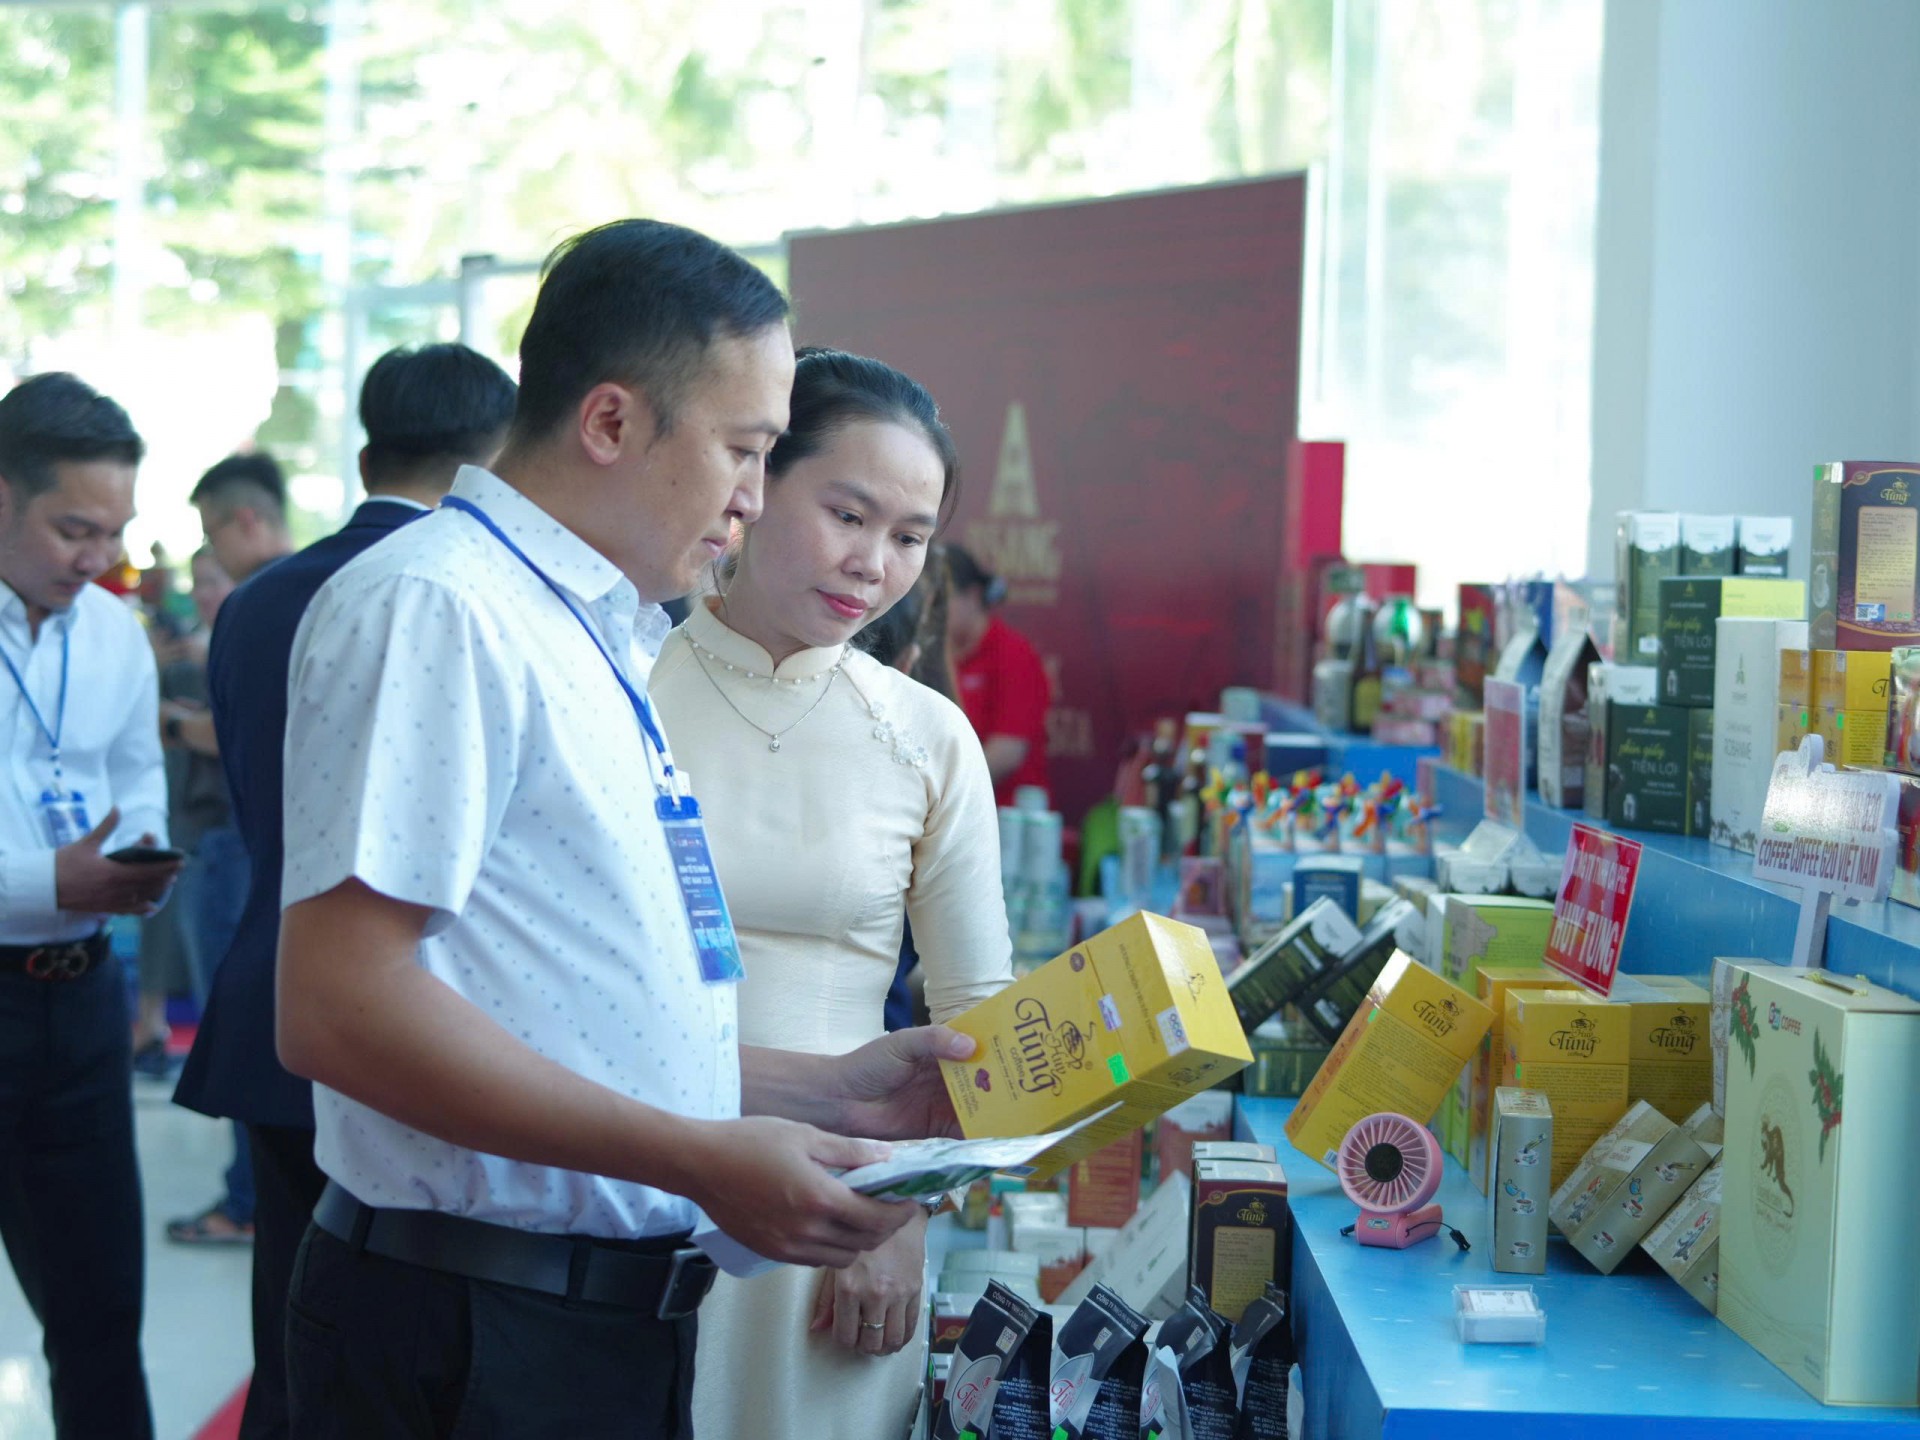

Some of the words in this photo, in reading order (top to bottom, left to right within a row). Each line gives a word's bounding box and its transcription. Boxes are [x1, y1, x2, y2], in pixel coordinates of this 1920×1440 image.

[1758, 838, 1793, 870] COFFEE
[1789, 836, 1823, 877] COFFEE
[1856, 846, 1880, 888] NAM
[1550, 901, 1585, 957] HUY
[1413, 1000, 1458, 1039] Tùng
[1781, 1015, 1802, 1036] COFFEE
[1014, 997, 1064, 1097] Tùng
[1549, 1030, 1601, 1058] Tùng
[1649, 1027, 1701, 1056] Tùng
[1010, 1046, 1026, 1081] coffee
